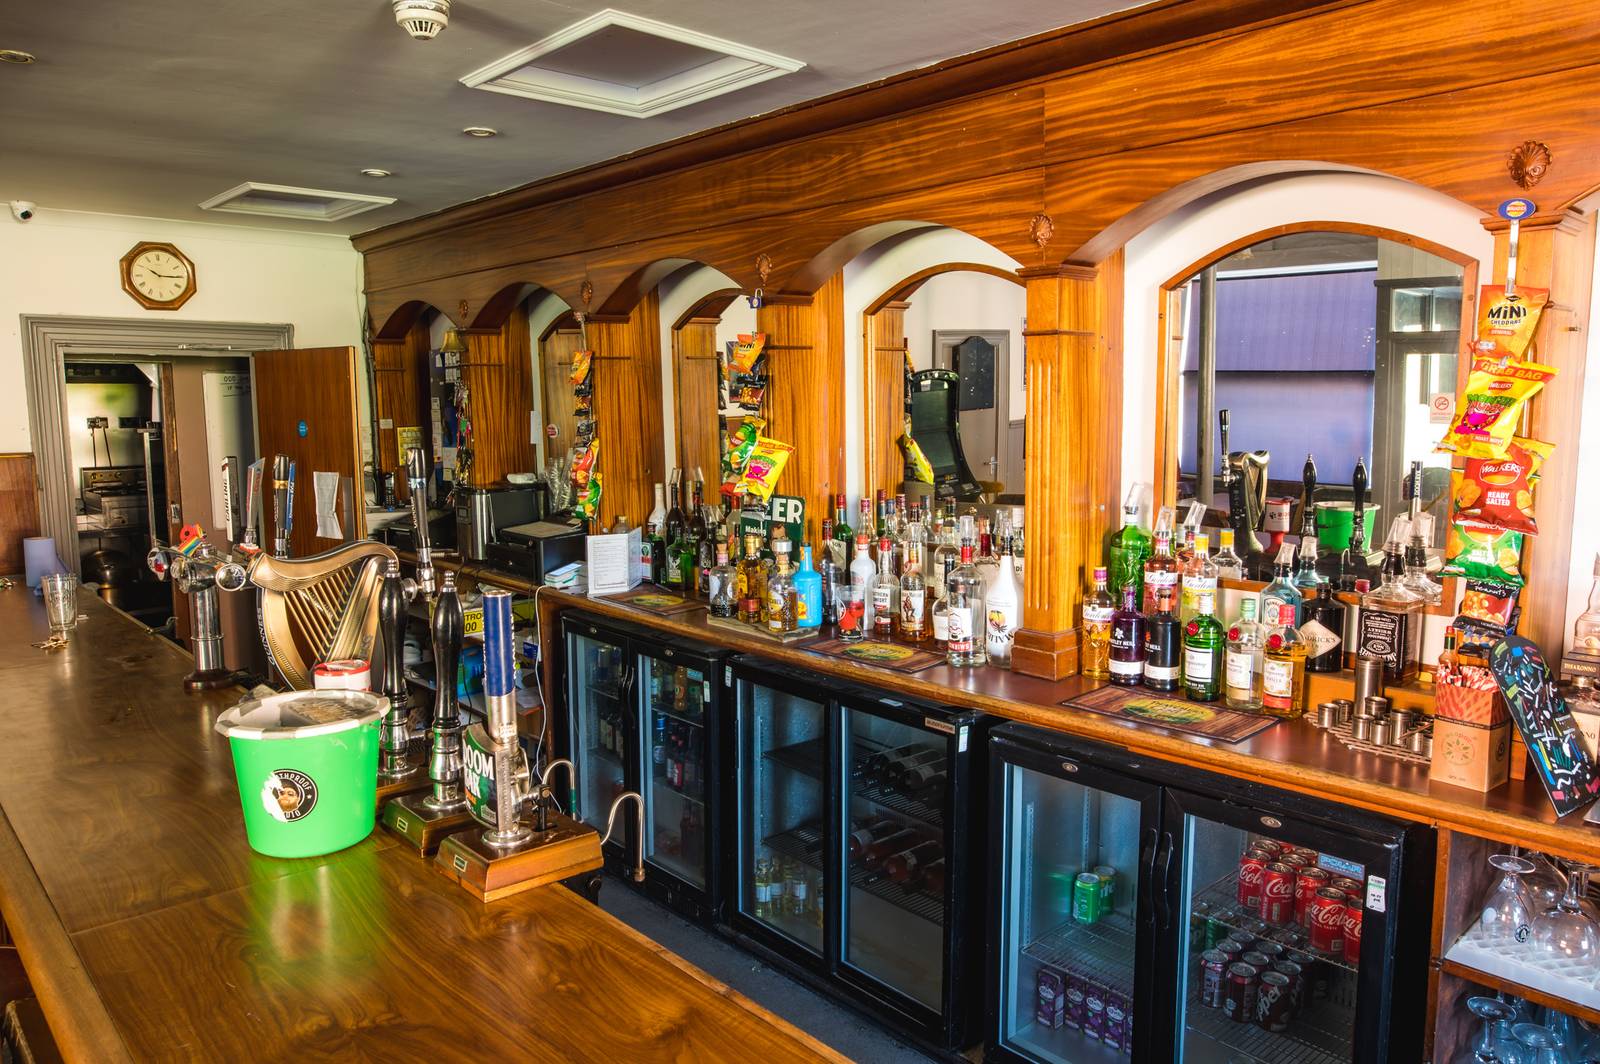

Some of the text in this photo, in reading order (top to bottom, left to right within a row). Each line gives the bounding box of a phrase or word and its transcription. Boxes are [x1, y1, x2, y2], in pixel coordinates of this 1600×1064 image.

[1481, 360, 1543, 381] GRAB BAG
[1481, 462, 1521, 474] WALKERS
[1487, 491, 1510, 499] READY
[223, 481, 231, 522] CARLING
[1485, 498, 1511, 507] SALTED
[257, 607, 276, 667] GUINNESS
[1563, 662, 1597, 674] DISARONNO
